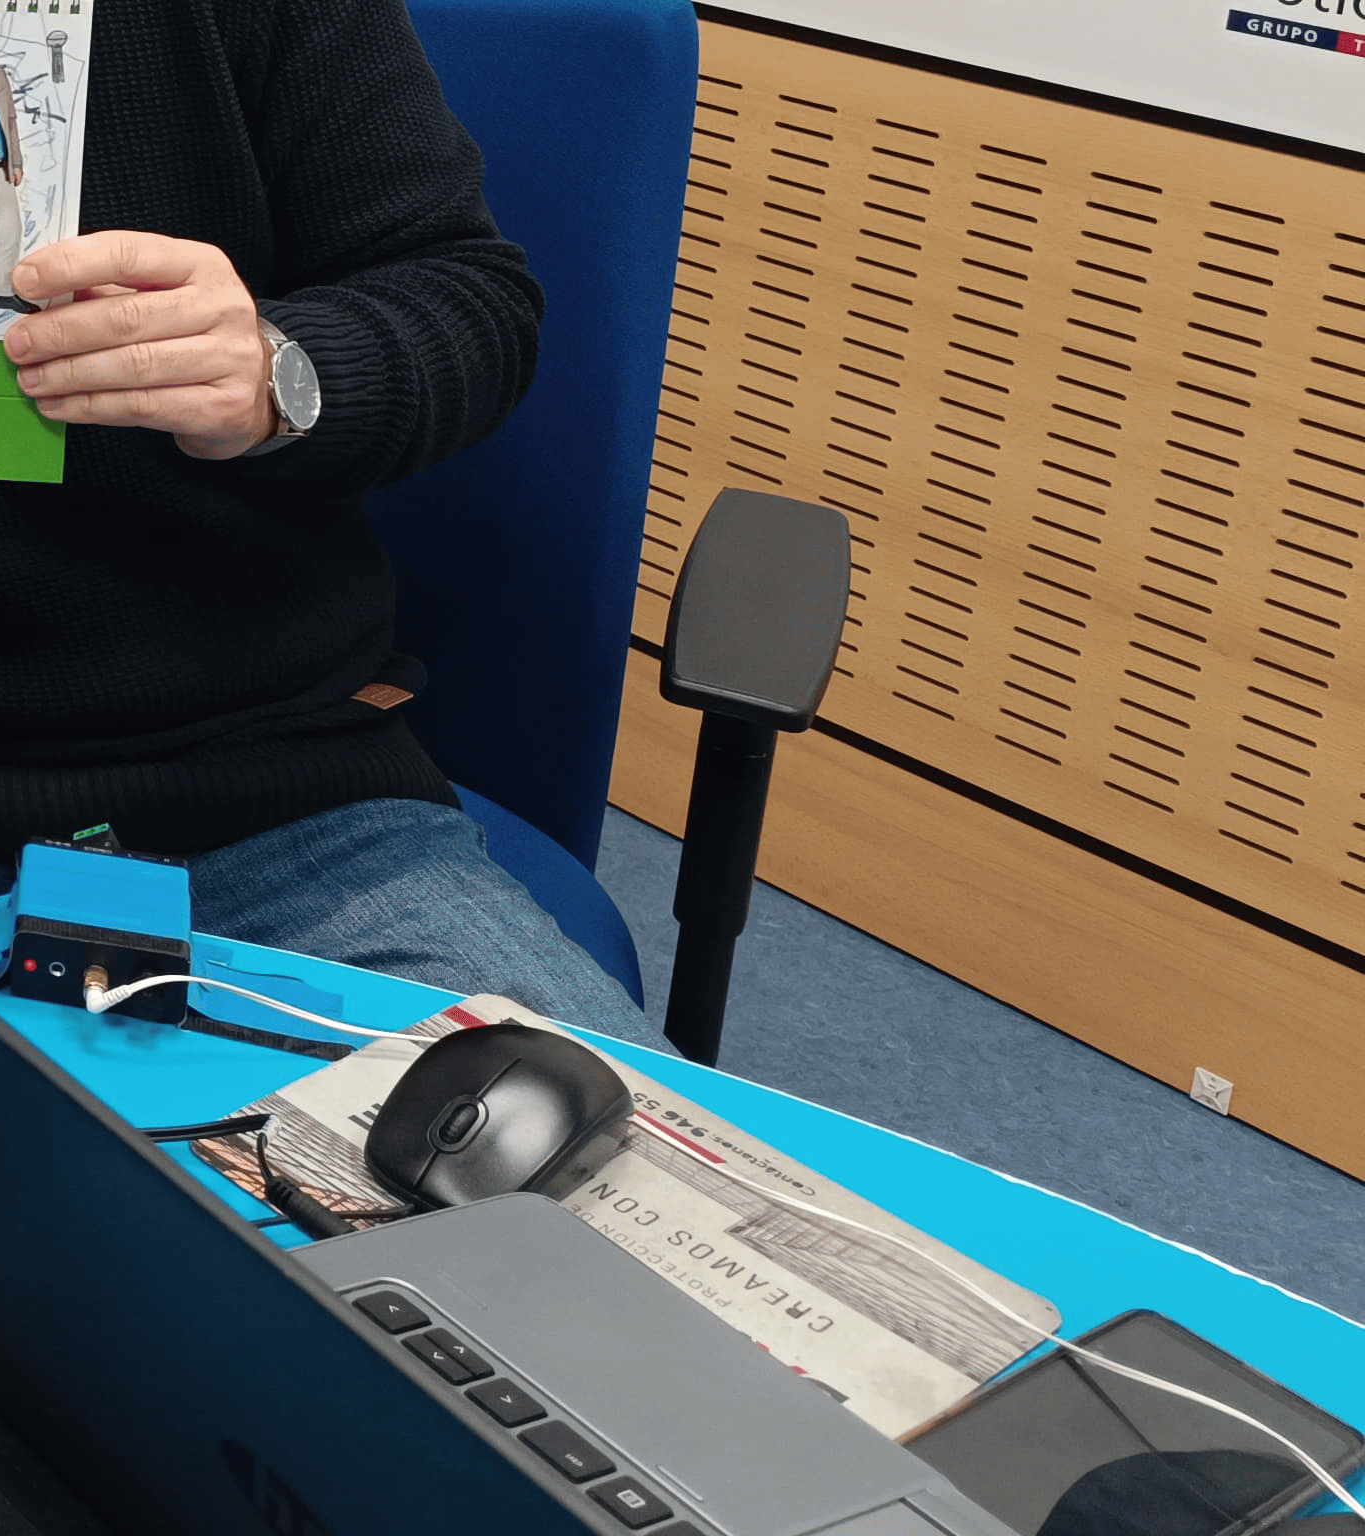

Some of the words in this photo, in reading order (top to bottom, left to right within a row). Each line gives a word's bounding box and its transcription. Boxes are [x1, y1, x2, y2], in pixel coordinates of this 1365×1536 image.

[1246, 18, 1318, 43] GRUPO
[660, 1109, 709, 1139] 946
[666, 1229, 836, 1336] CREAMOS
